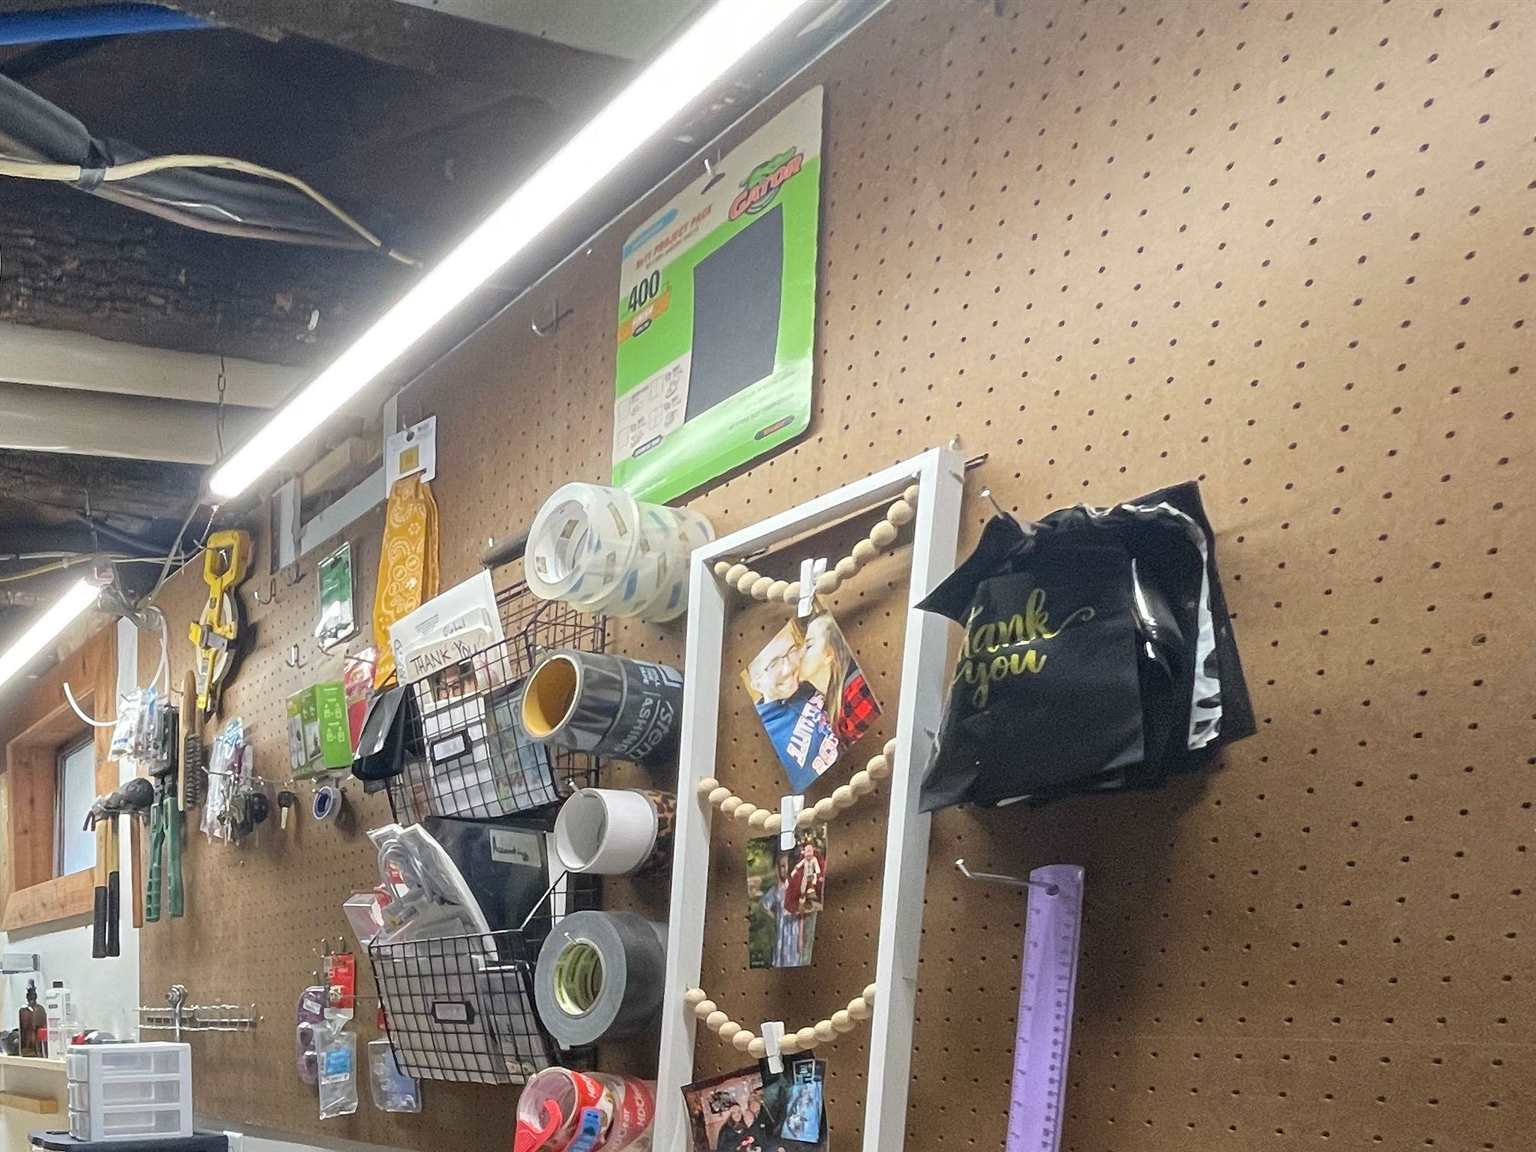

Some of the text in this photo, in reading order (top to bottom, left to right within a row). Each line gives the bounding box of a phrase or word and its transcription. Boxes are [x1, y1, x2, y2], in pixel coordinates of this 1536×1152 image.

[627, 269, 661, 313] 400
[409, 646, 452, 676] THANK
[954, 649, 1048, 708] you
